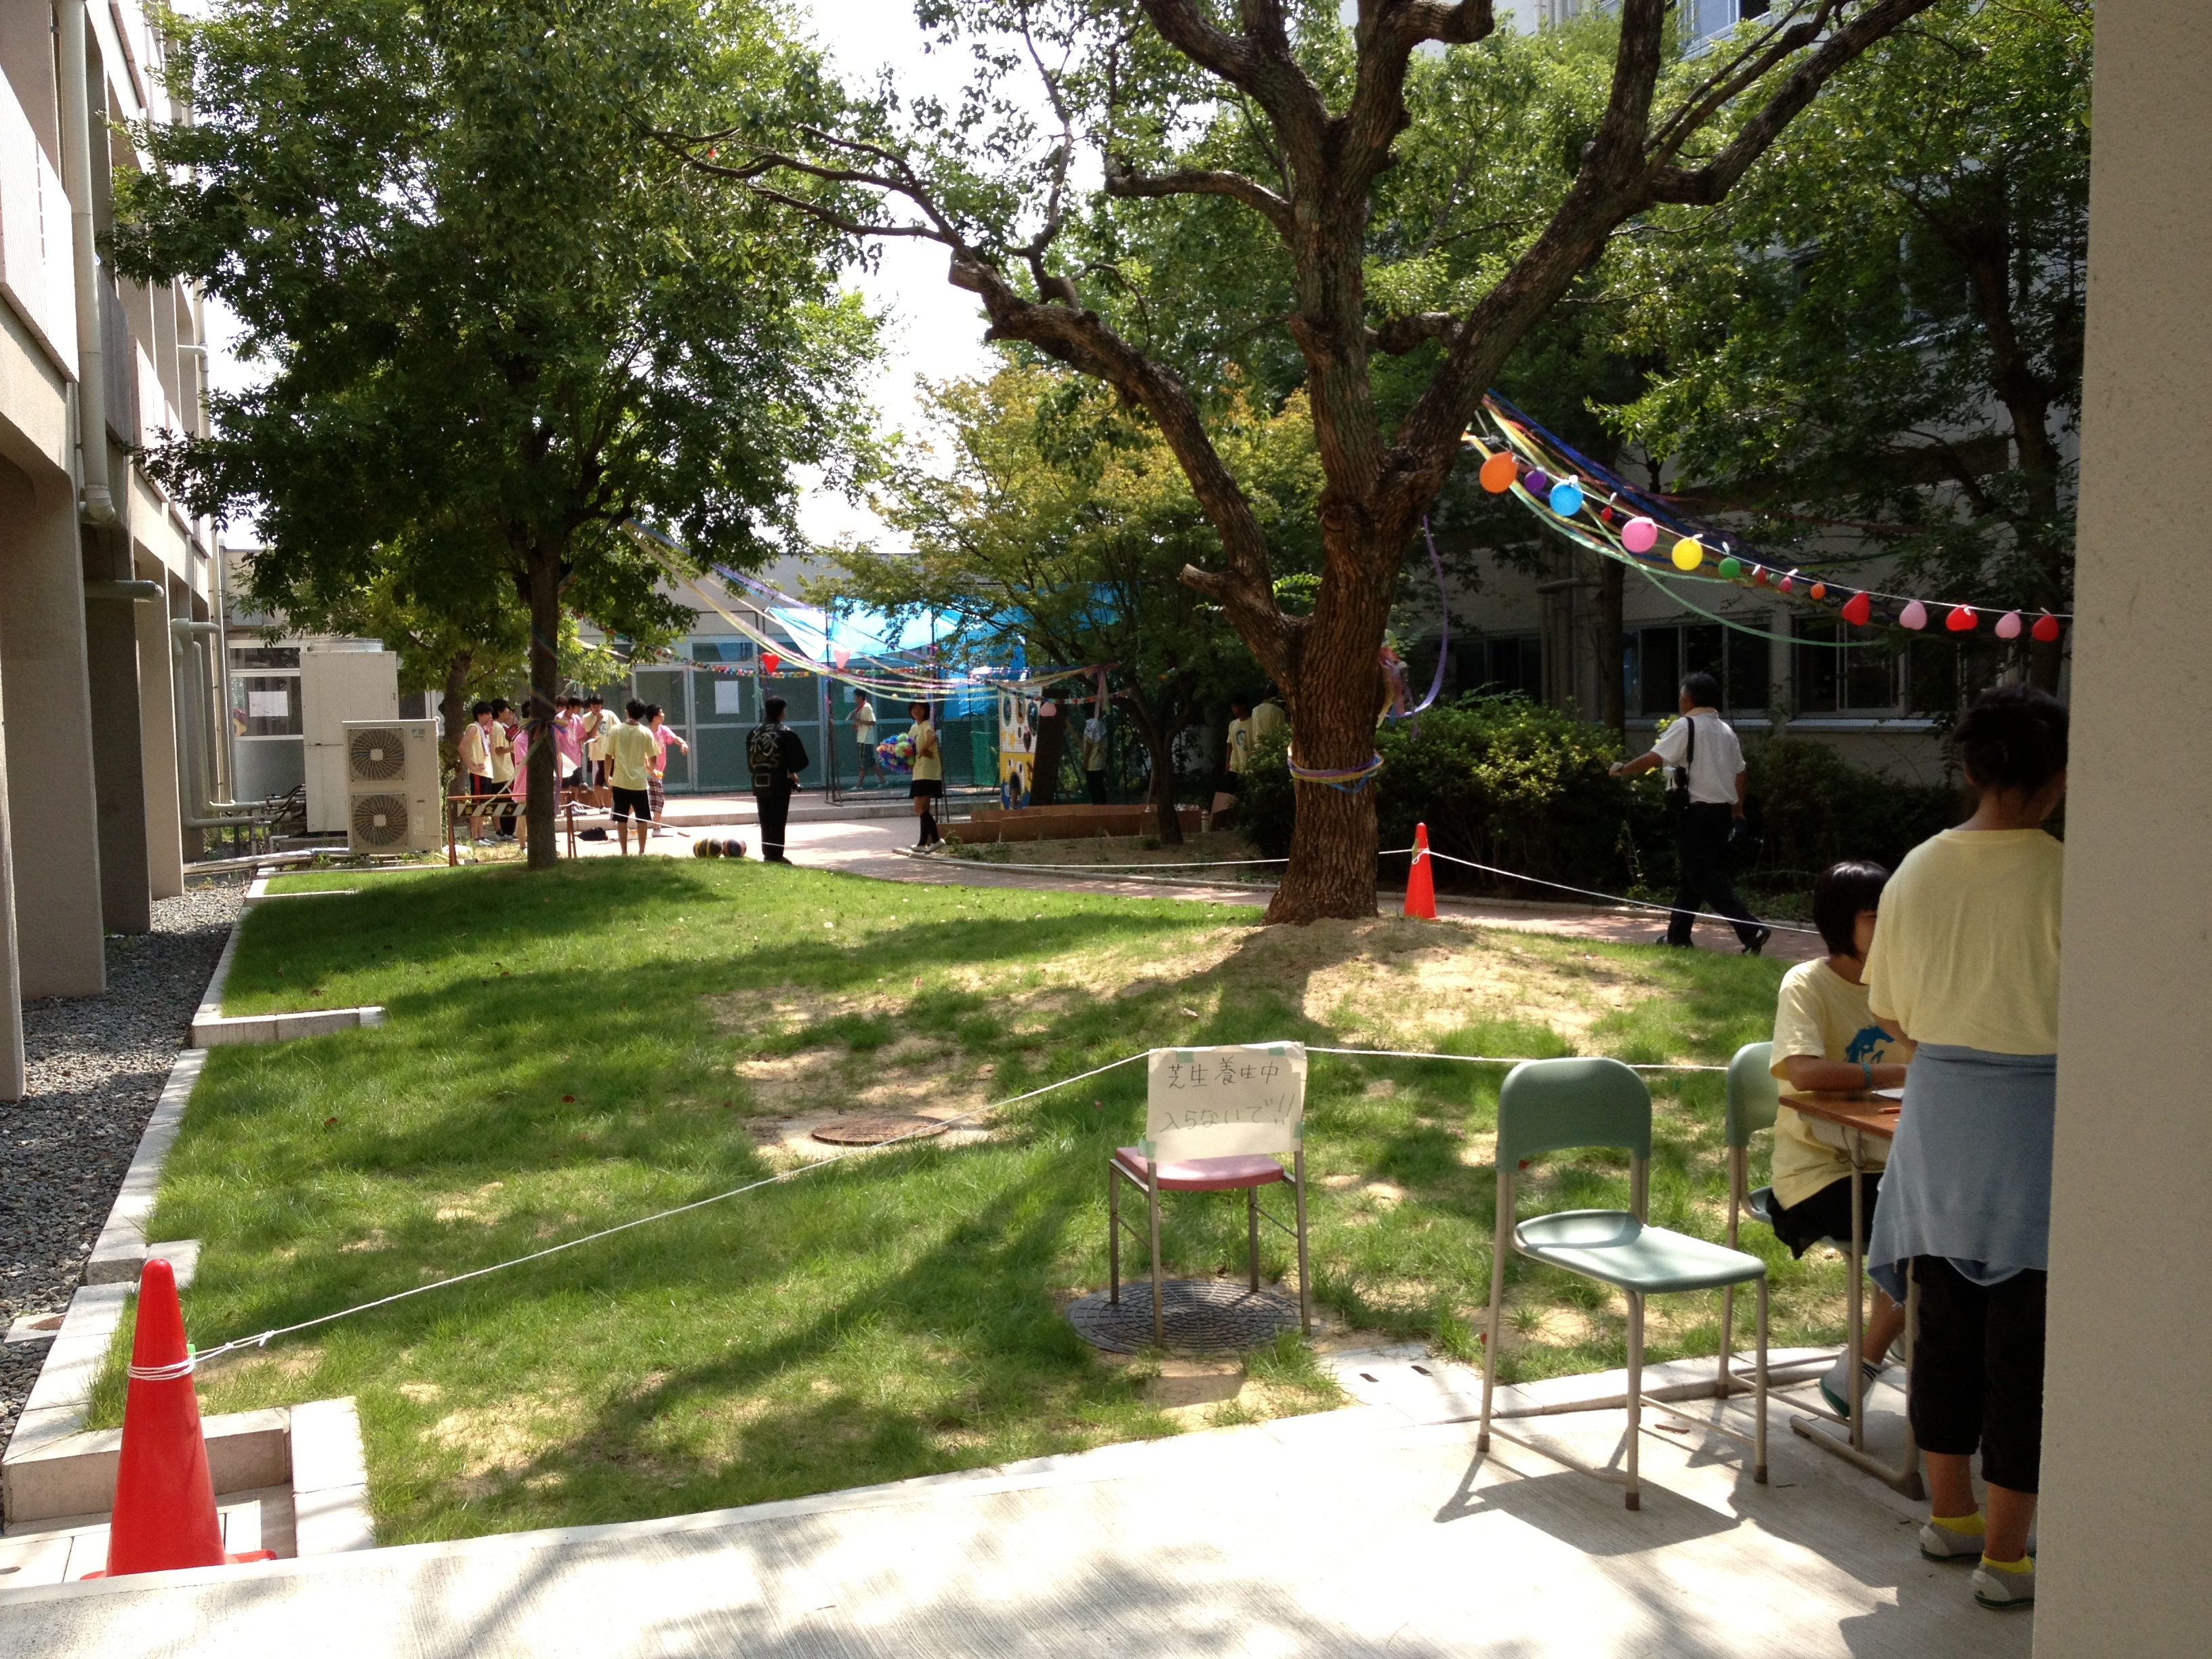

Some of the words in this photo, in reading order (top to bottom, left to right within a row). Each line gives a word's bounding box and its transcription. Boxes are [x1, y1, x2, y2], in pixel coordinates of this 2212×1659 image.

[1168, 1055, 1279, 1089] 芝生養生中
